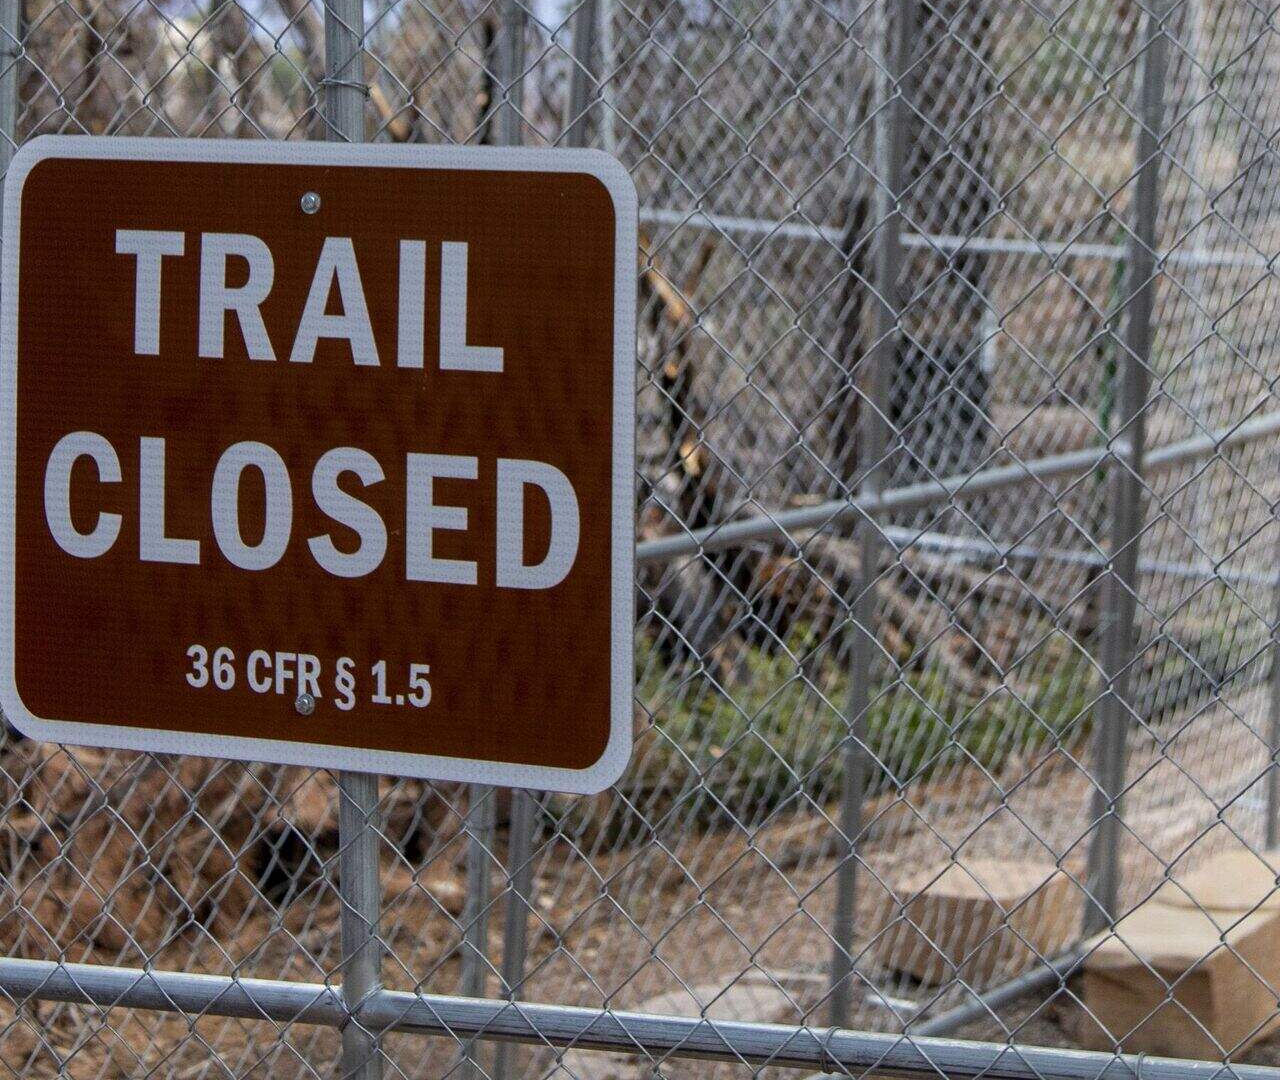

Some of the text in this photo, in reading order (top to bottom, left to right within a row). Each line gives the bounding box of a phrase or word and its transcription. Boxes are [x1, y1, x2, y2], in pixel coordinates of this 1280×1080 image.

[116, 230, 503, 372] TRAIL
[44, 432, 579, 589] CLOSED
[186, 645, 431, 710] 36 CFR § 1.5
